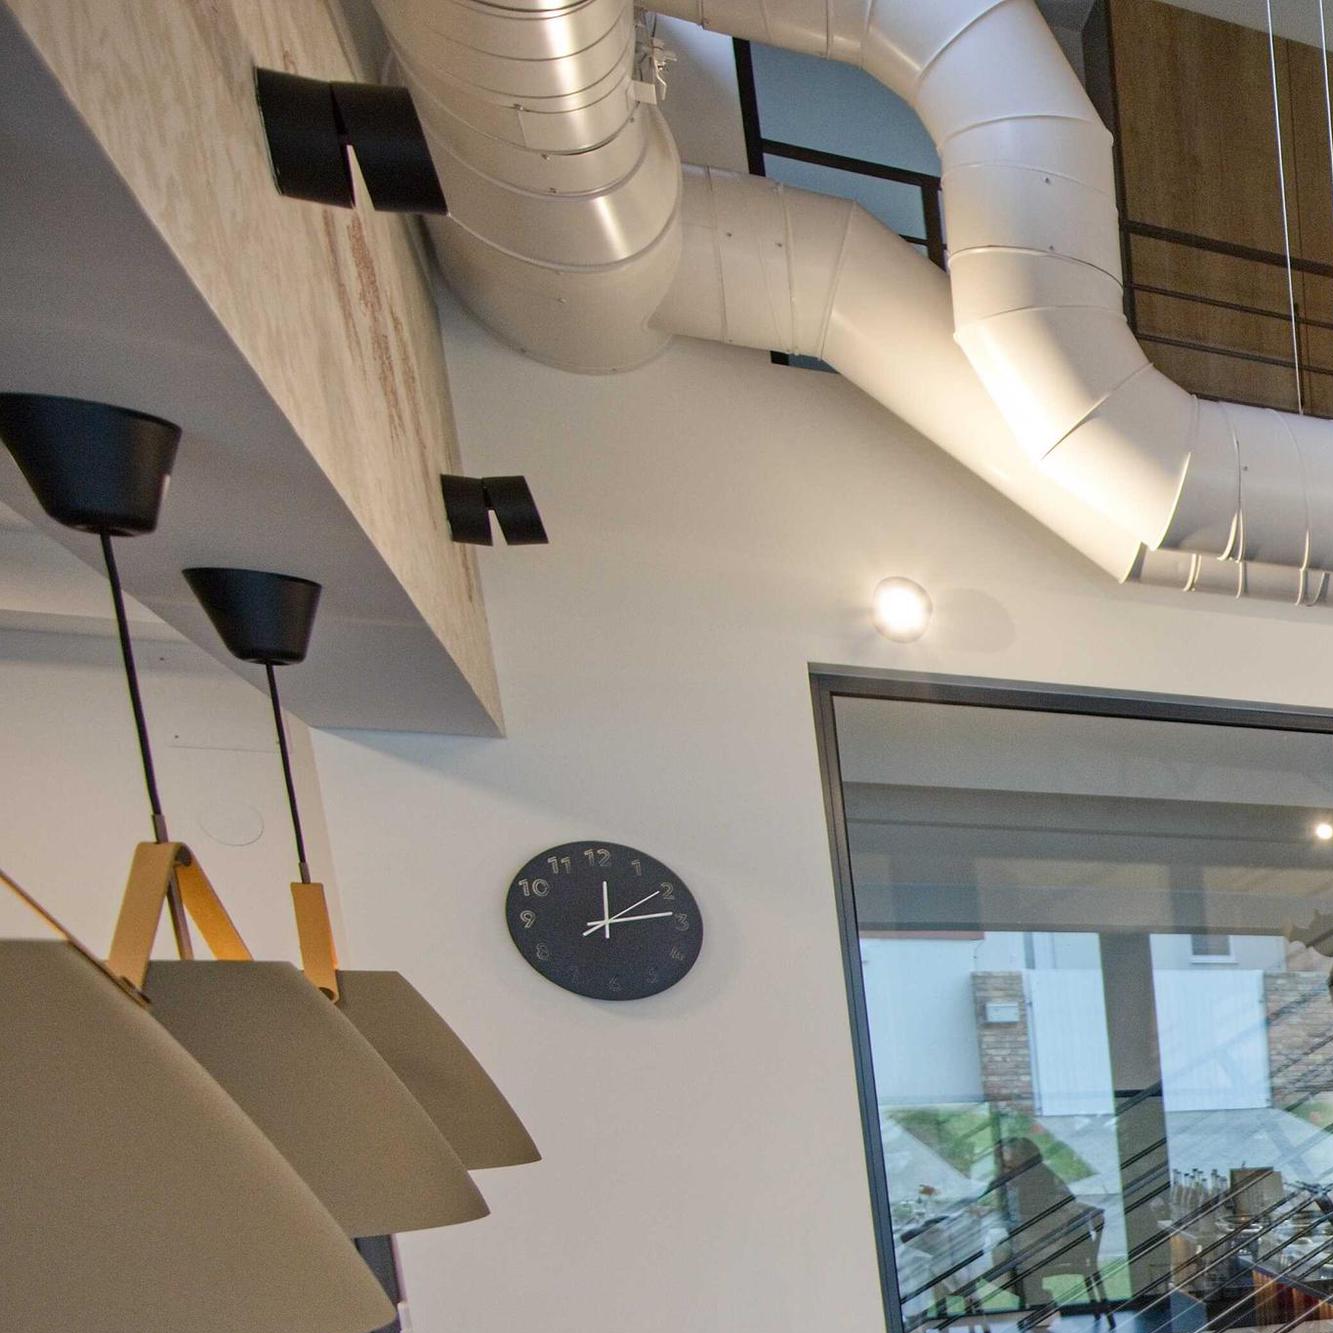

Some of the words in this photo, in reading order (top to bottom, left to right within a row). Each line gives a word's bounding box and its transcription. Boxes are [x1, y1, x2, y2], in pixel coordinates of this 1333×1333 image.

[547, 856, 572, 874] 11
[584, 849, 611, 867] 12
[631, 859, 642, 876] 1
[518, 879, 551, 897] 10
[660, 882, 675, 900] 2
[519, 910, 537, 928] 9
[673, 913, 689, 931] 3
[536, 943, 550, 960] 8
